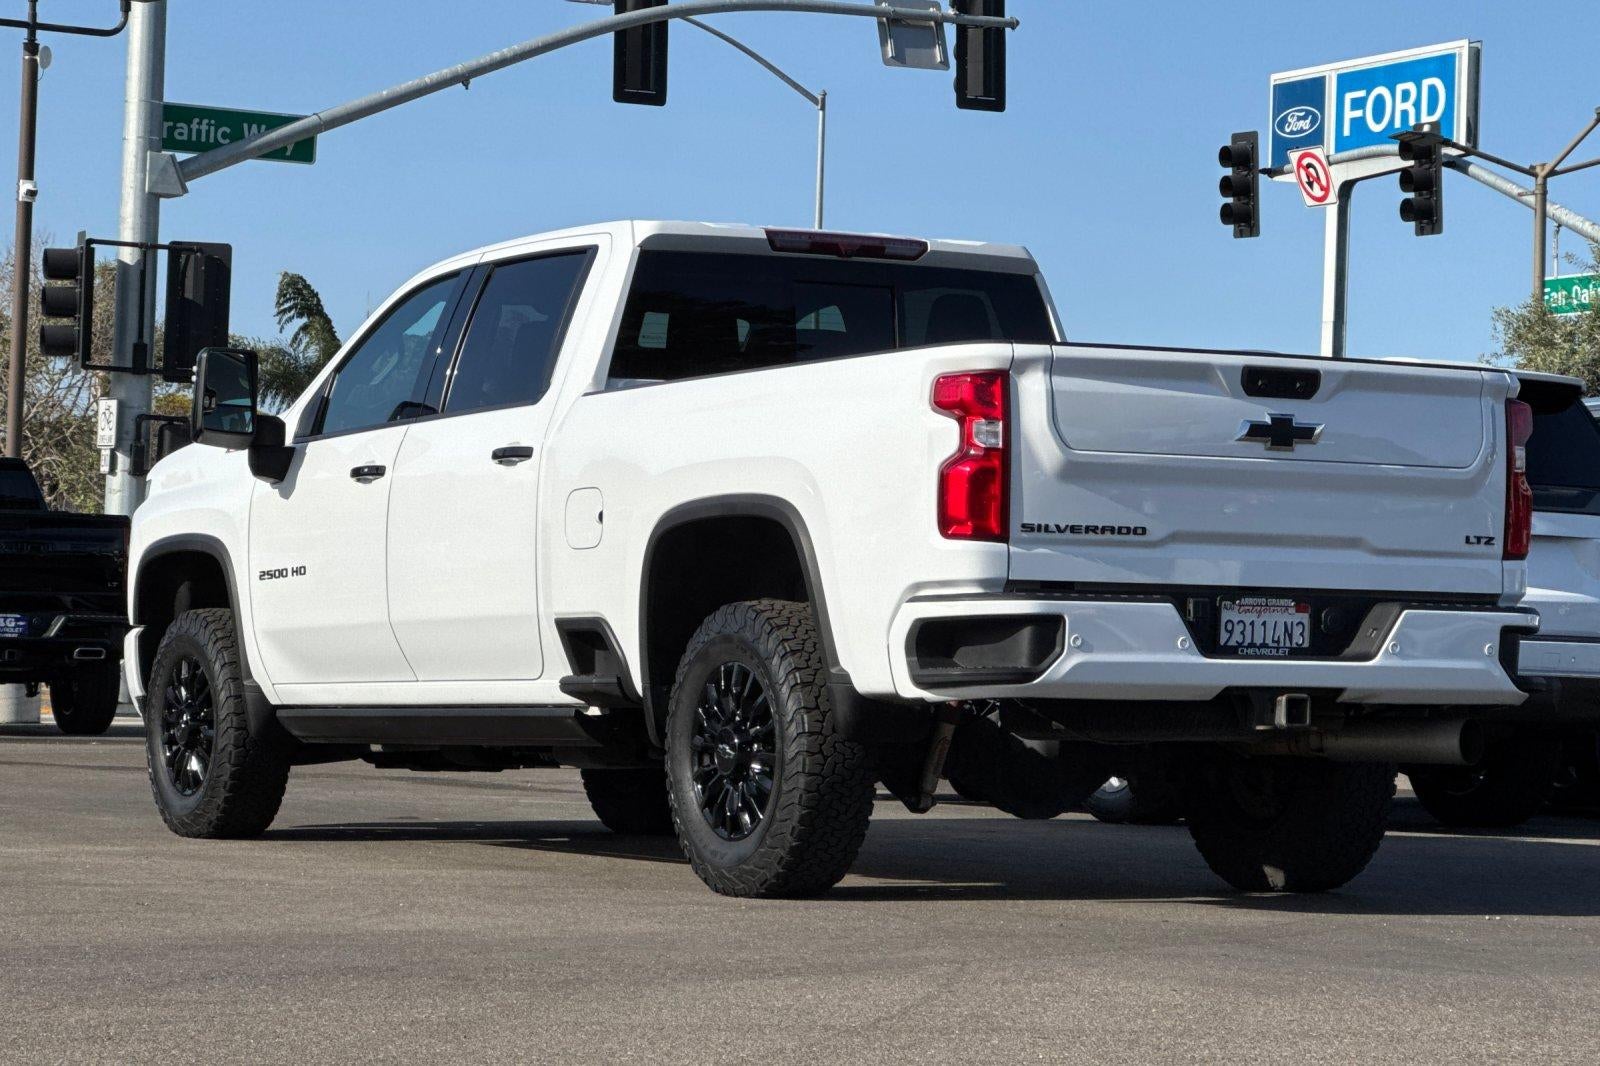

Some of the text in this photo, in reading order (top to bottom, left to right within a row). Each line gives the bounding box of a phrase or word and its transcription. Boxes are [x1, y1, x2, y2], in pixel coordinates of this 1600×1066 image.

[1343, 77, 1447, 137] FORD
[1285, 111, 1312, 133] Ford
[162, 117, 232, 145] raffic
[1020, 523, 1147, 536] SILVERADO
[1465, 535, 1496, 546] LTZ
[259, 565, 307, 581] 2500 HD
[1241, 597, 1293, 606] ARROYO GRANDE
[1238, 605, 1295, 618] California
[1223, 618, 1305, 647] 93114N3
[1238, 647, 1290, 656] CHEVROLET
